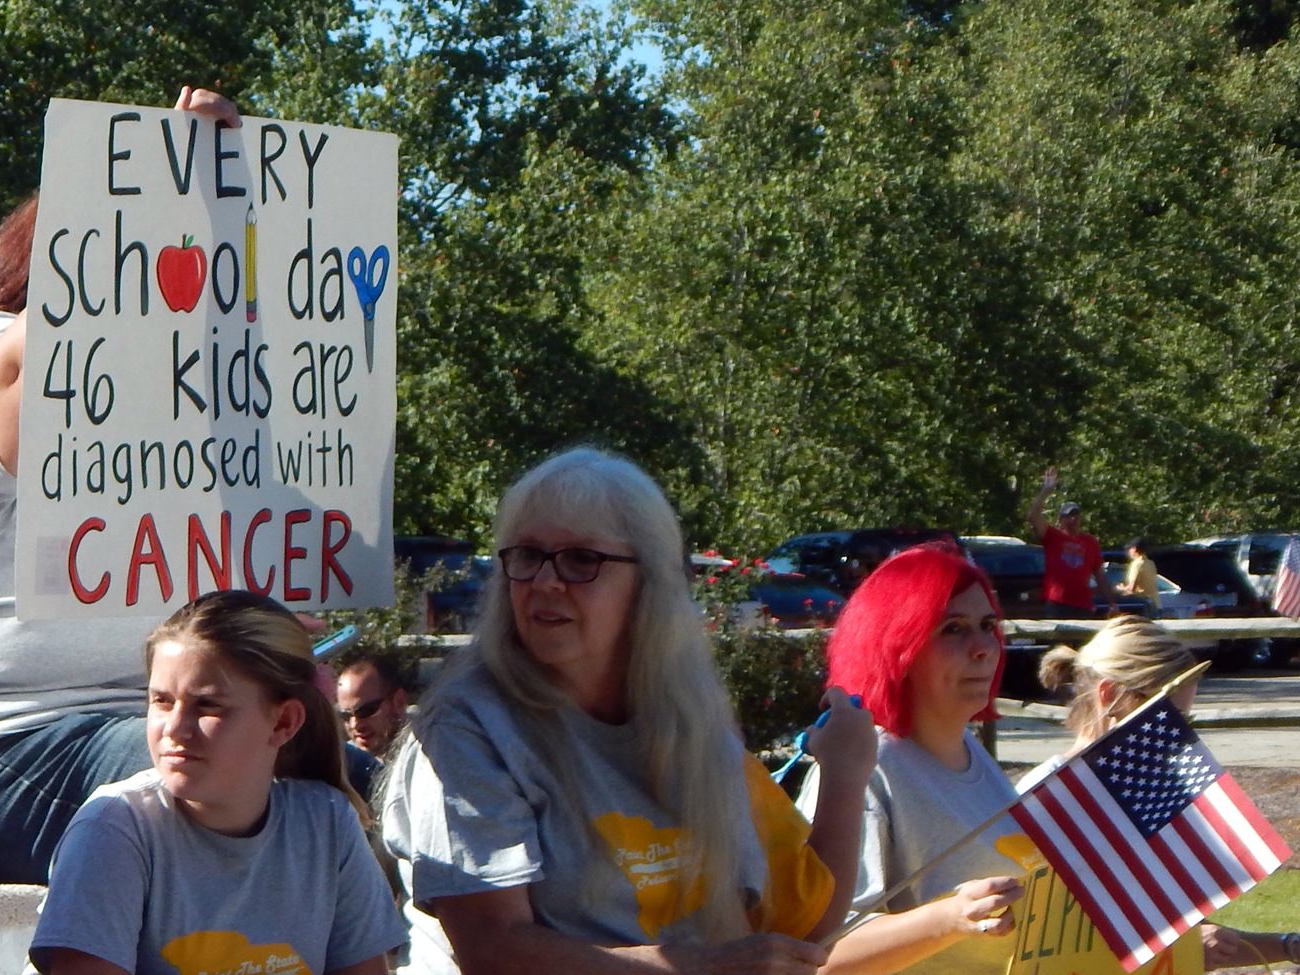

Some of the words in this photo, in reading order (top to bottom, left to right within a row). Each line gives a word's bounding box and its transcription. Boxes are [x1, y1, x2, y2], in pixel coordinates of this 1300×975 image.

[108, 112, 329, 209] EVERY
[43, 337, 115, 429] 46
[292, 340, 357, 420] are
[41, 429, 261, 505] diagnosed
[277, 430, 354, 488] with
[67, 507, 355, 606] CANCER
